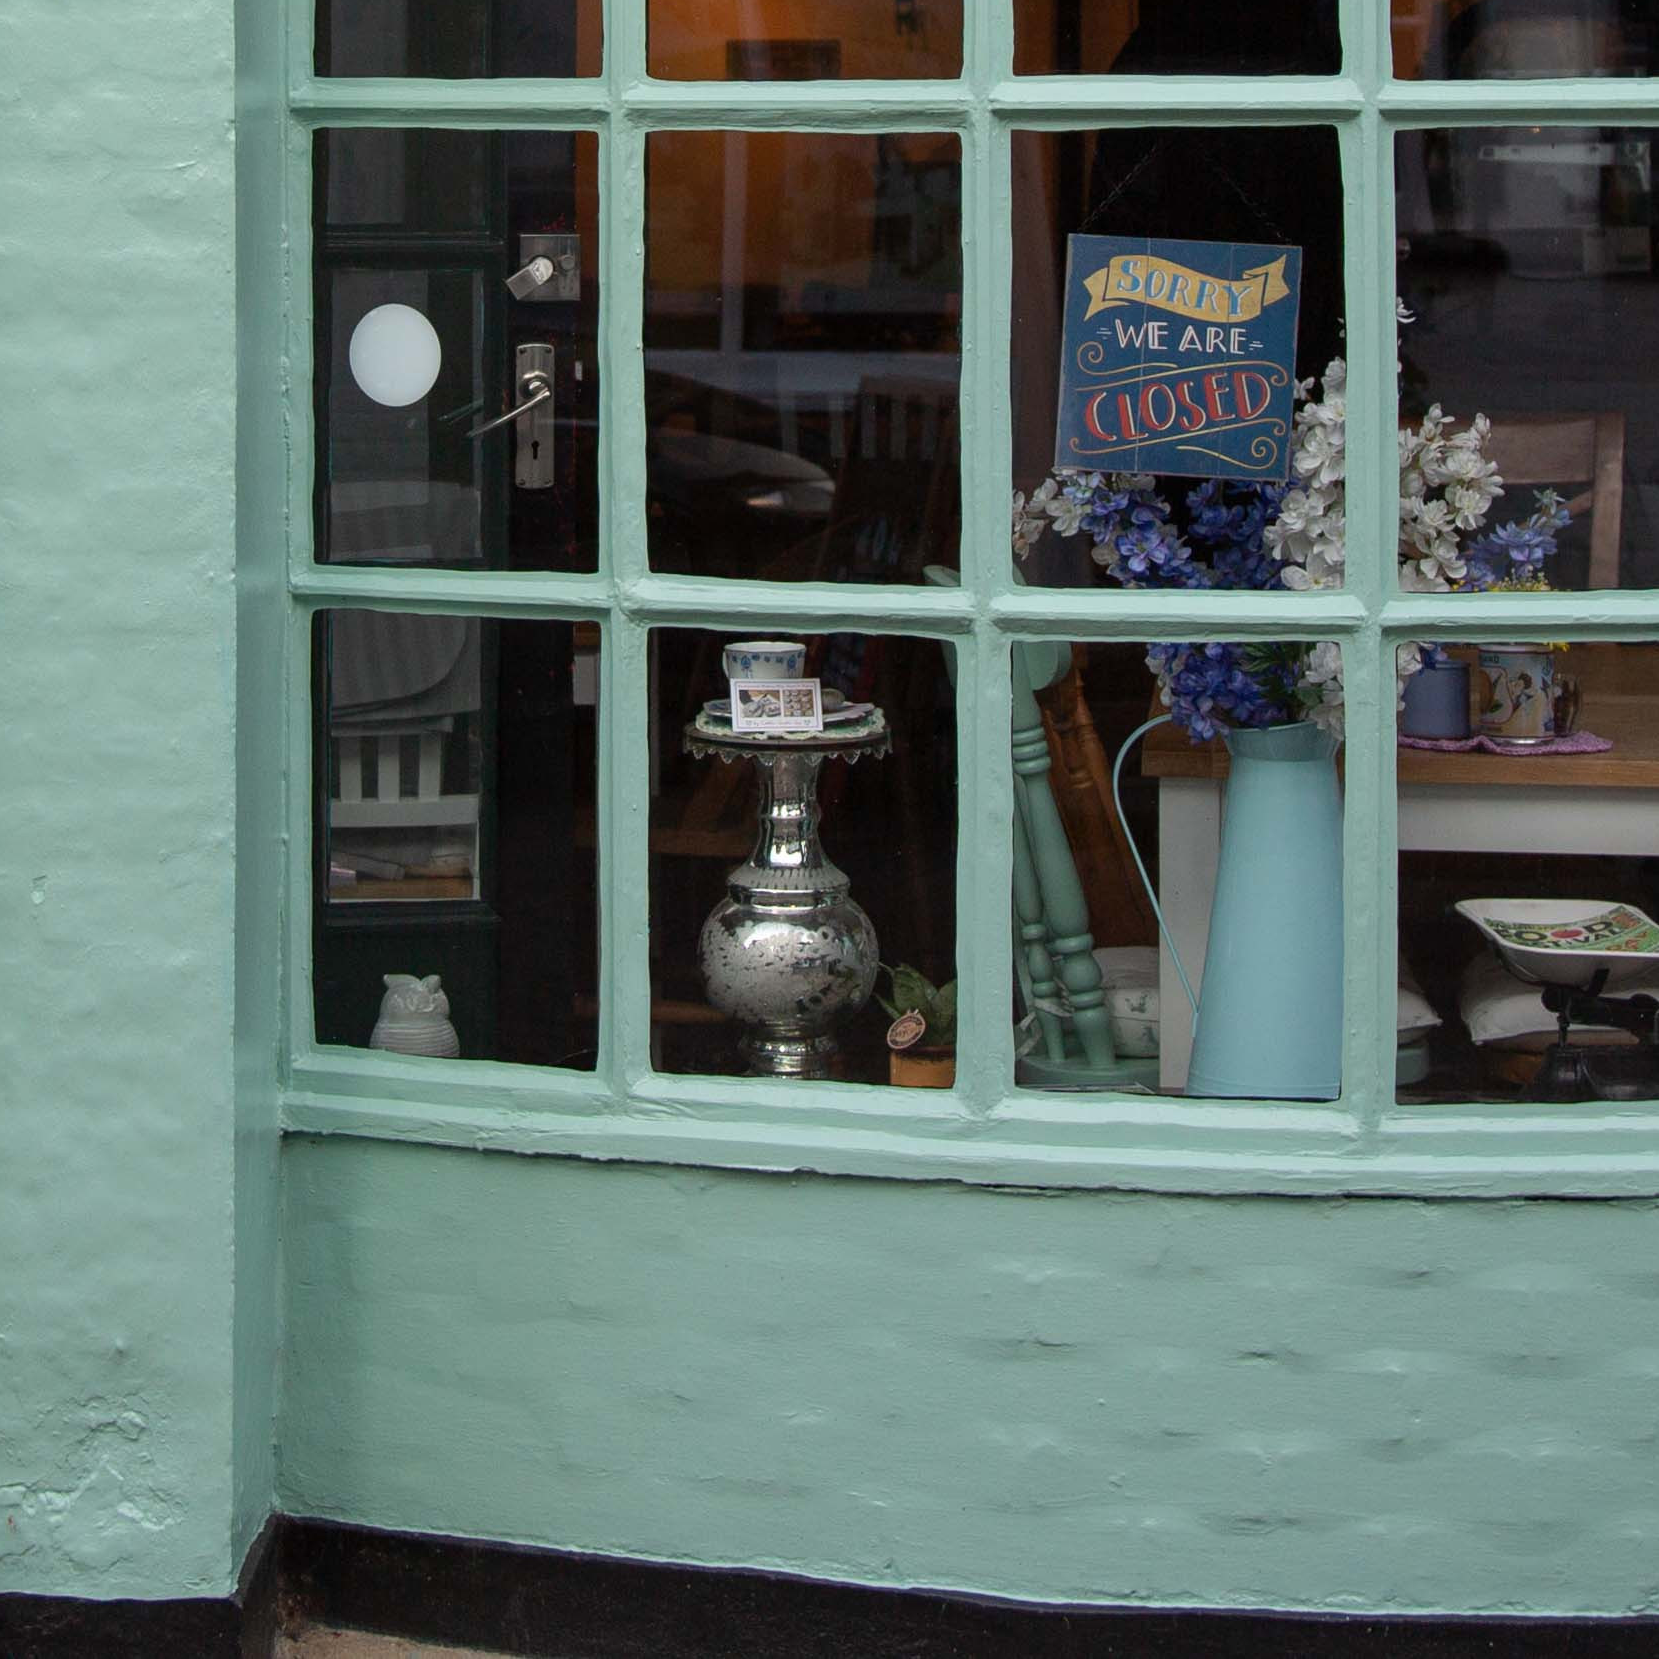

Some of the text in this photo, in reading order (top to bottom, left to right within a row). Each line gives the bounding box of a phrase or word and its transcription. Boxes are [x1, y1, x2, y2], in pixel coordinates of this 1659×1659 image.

[1118, 259, 1253, 318] SORRY
[1115, 319, 1249, 355] WE ARE
[1084, 371, 1271, 442] CLOSED
